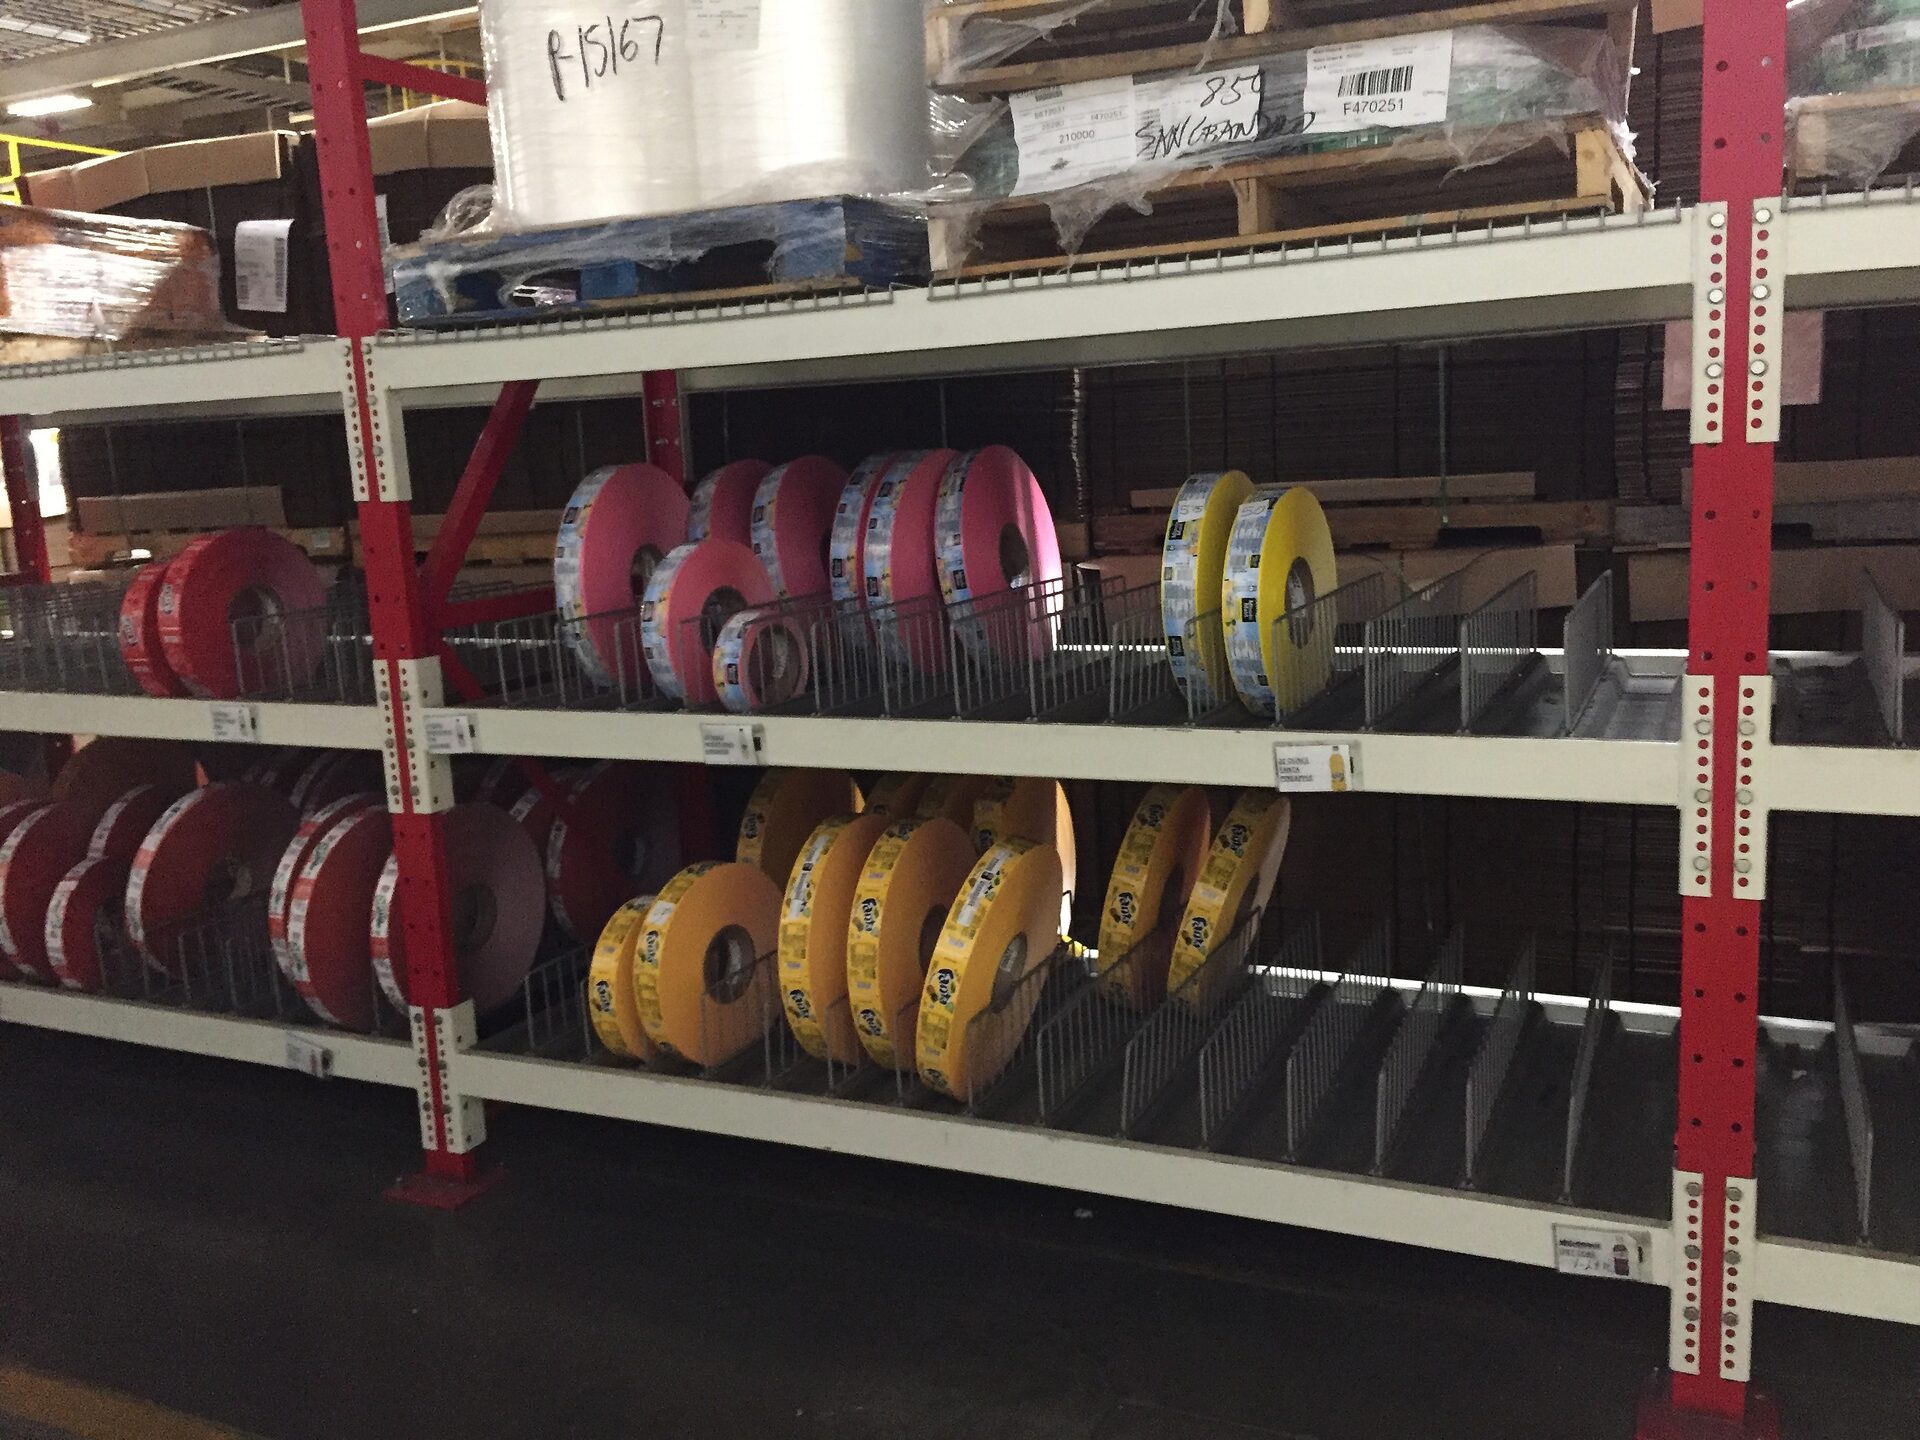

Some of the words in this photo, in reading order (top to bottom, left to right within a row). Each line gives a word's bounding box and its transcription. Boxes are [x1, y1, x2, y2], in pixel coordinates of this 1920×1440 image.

[1343, 98, 1404, 115] F470251
[1058, 129, 1096, 144] 210000
[863, 897, 878, 932] Fanta
[1118, 892, 1134, 924] Fanta
[937, 968, 955, 1005] Fanta
